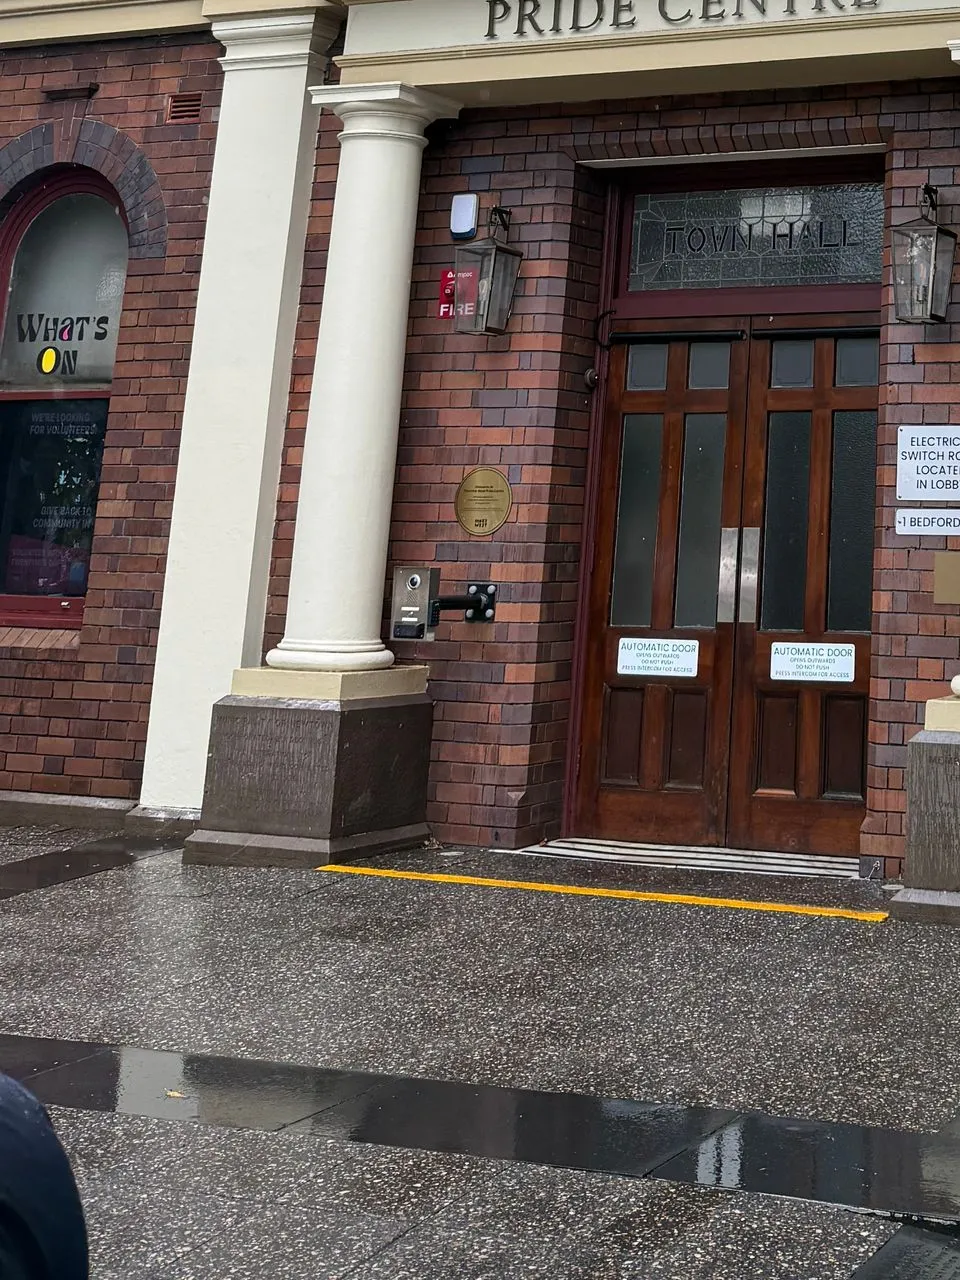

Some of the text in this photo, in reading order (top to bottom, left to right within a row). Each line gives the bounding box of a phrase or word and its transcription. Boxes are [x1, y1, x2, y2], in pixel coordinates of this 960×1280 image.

[666, 220, 863, 254] TOWN HALL
[440, 303, 474, 317] FIRE
[901, 451, 945, 461] SWITCH
[916, 480, 928, 489] IN
[910, 517, 960, 528] BEDFORD
[621, 642, 697, 653] AUTOMATIC DOOR
[774, 647, 853, 657] AUTOMATIC DOOR
